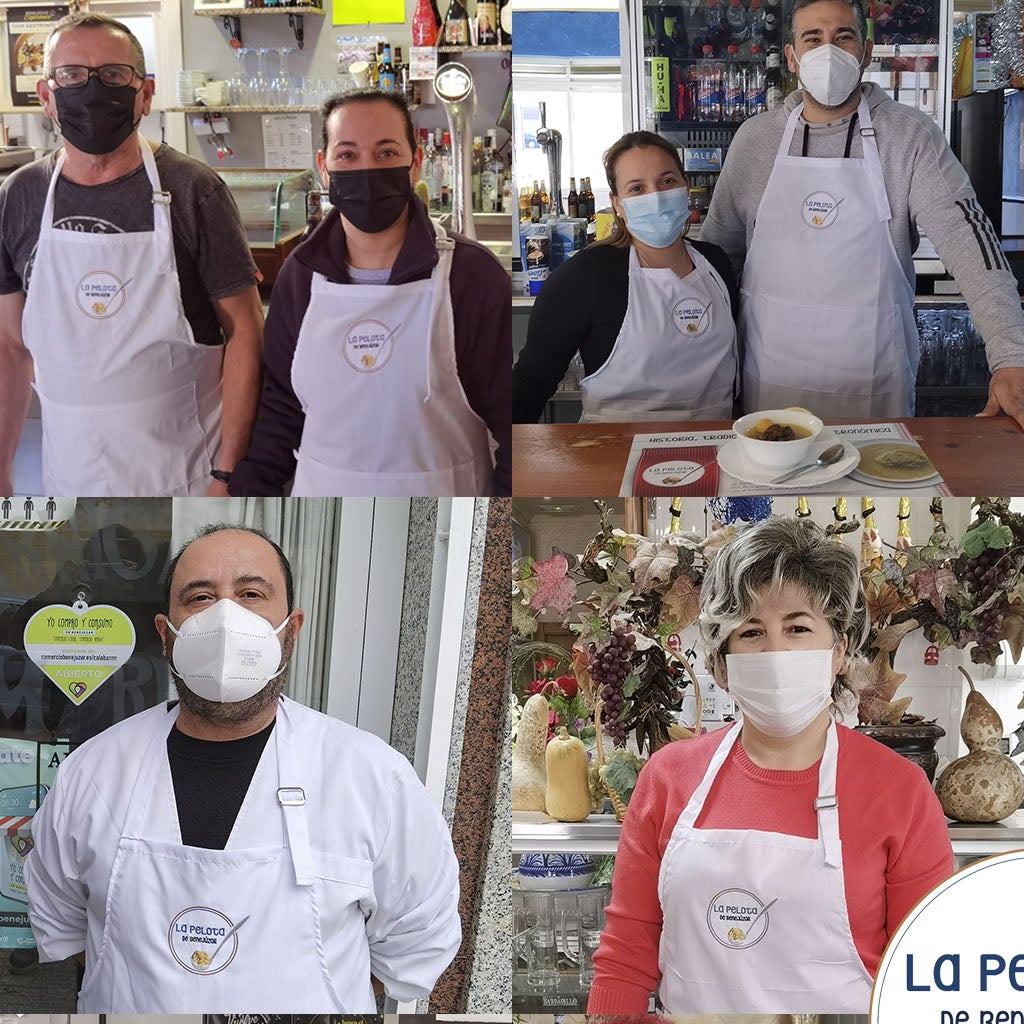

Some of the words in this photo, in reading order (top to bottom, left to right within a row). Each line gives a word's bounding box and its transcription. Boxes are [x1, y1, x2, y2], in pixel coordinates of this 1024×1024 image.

[687, 152, 718, 160] BALEA
[47, 617, 55, 627] YO
[57, 617, 79, 628] COMPRO
[55, 669, 103, 679] ABIERTO
